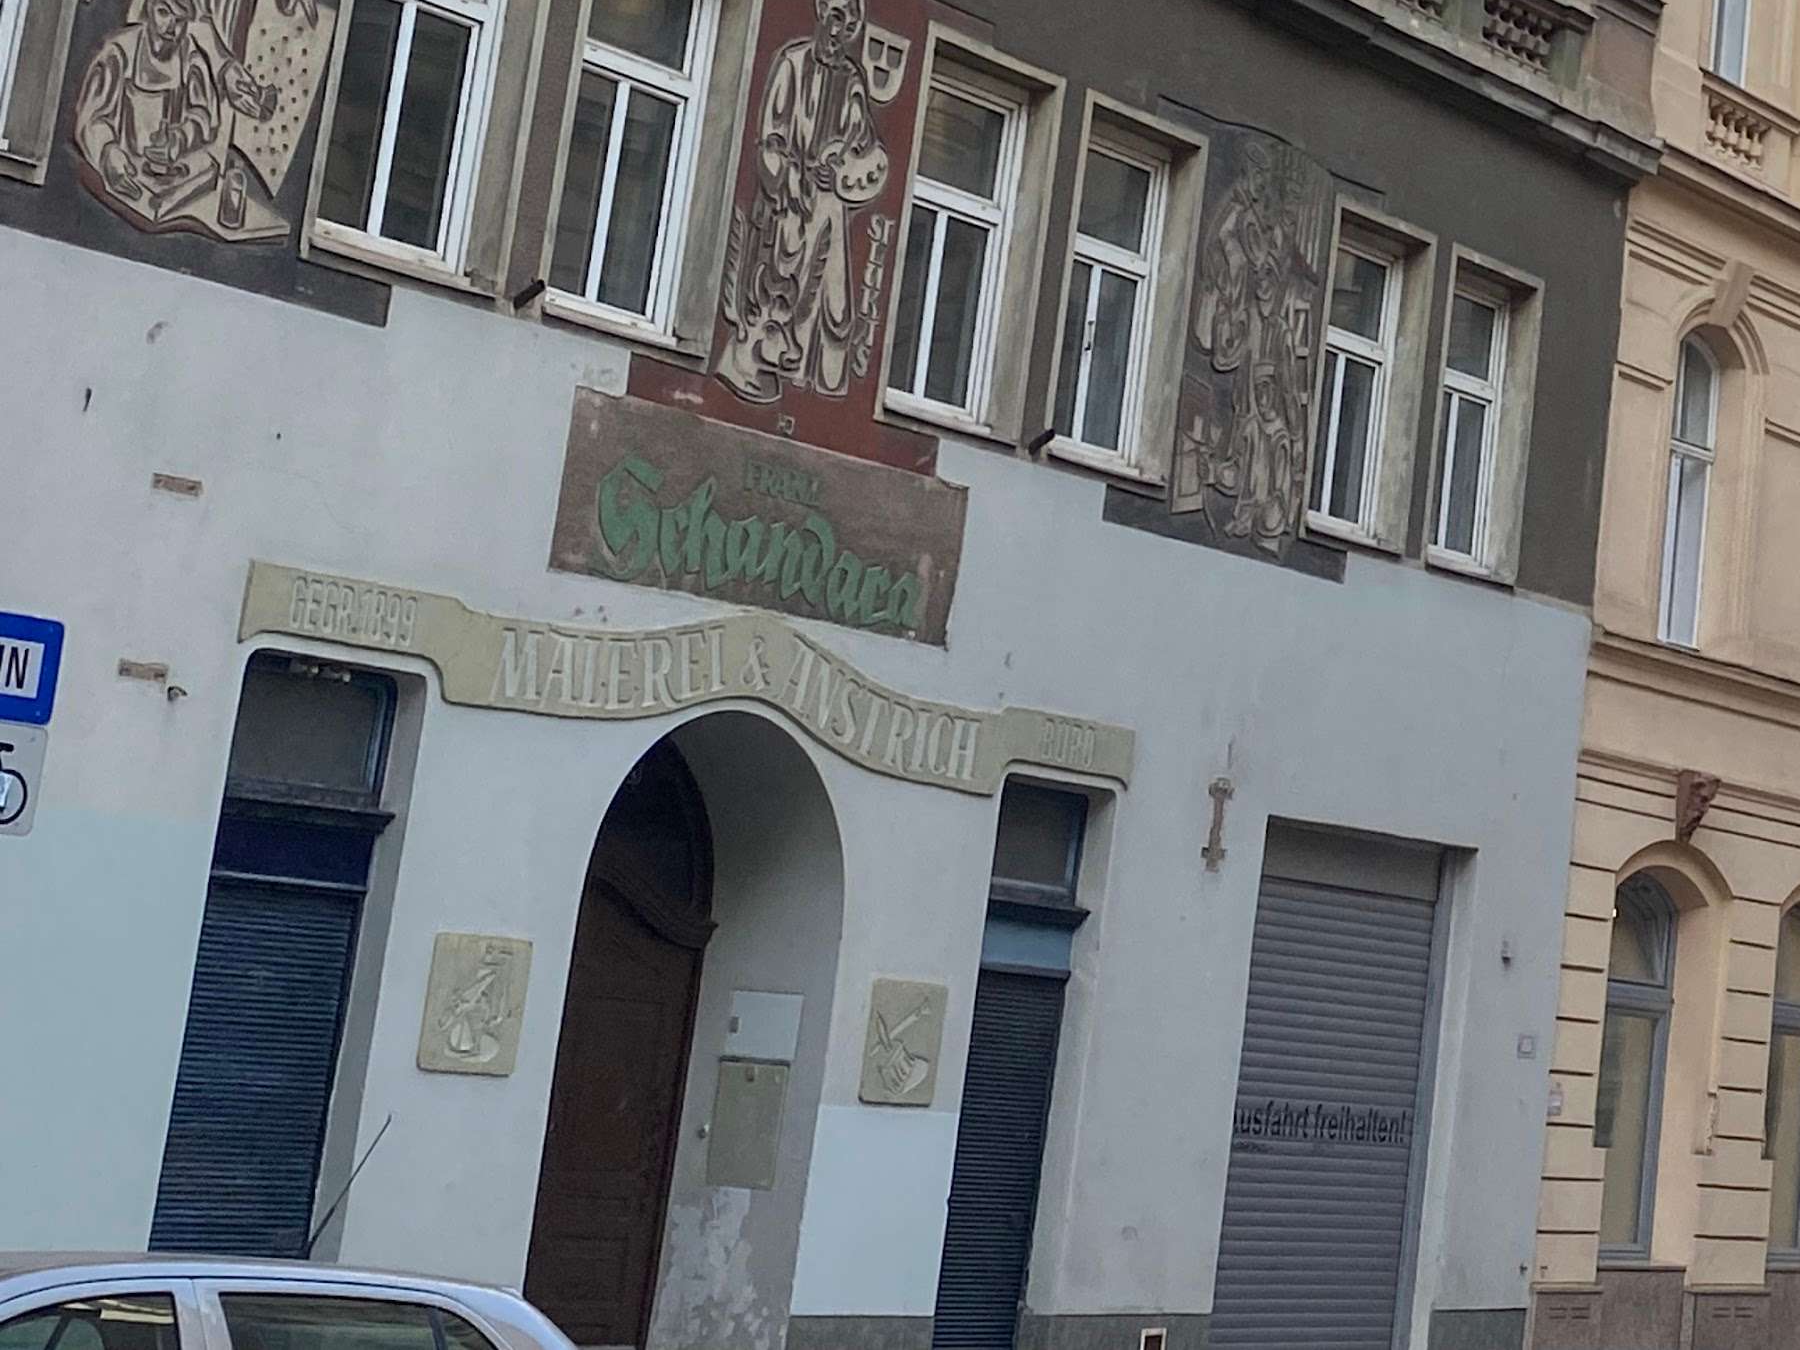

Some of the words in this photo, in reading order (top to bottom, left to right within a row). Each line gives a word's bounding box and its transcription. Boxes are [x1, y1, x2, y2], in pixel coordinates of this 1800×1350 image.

[489, 623, 726, 711] MALEREI
[740, 634, 771, 693] &
[776, 632, 983, 781] ANSTRICH
[1312, 1103, 1407, 1144] freihalten!
